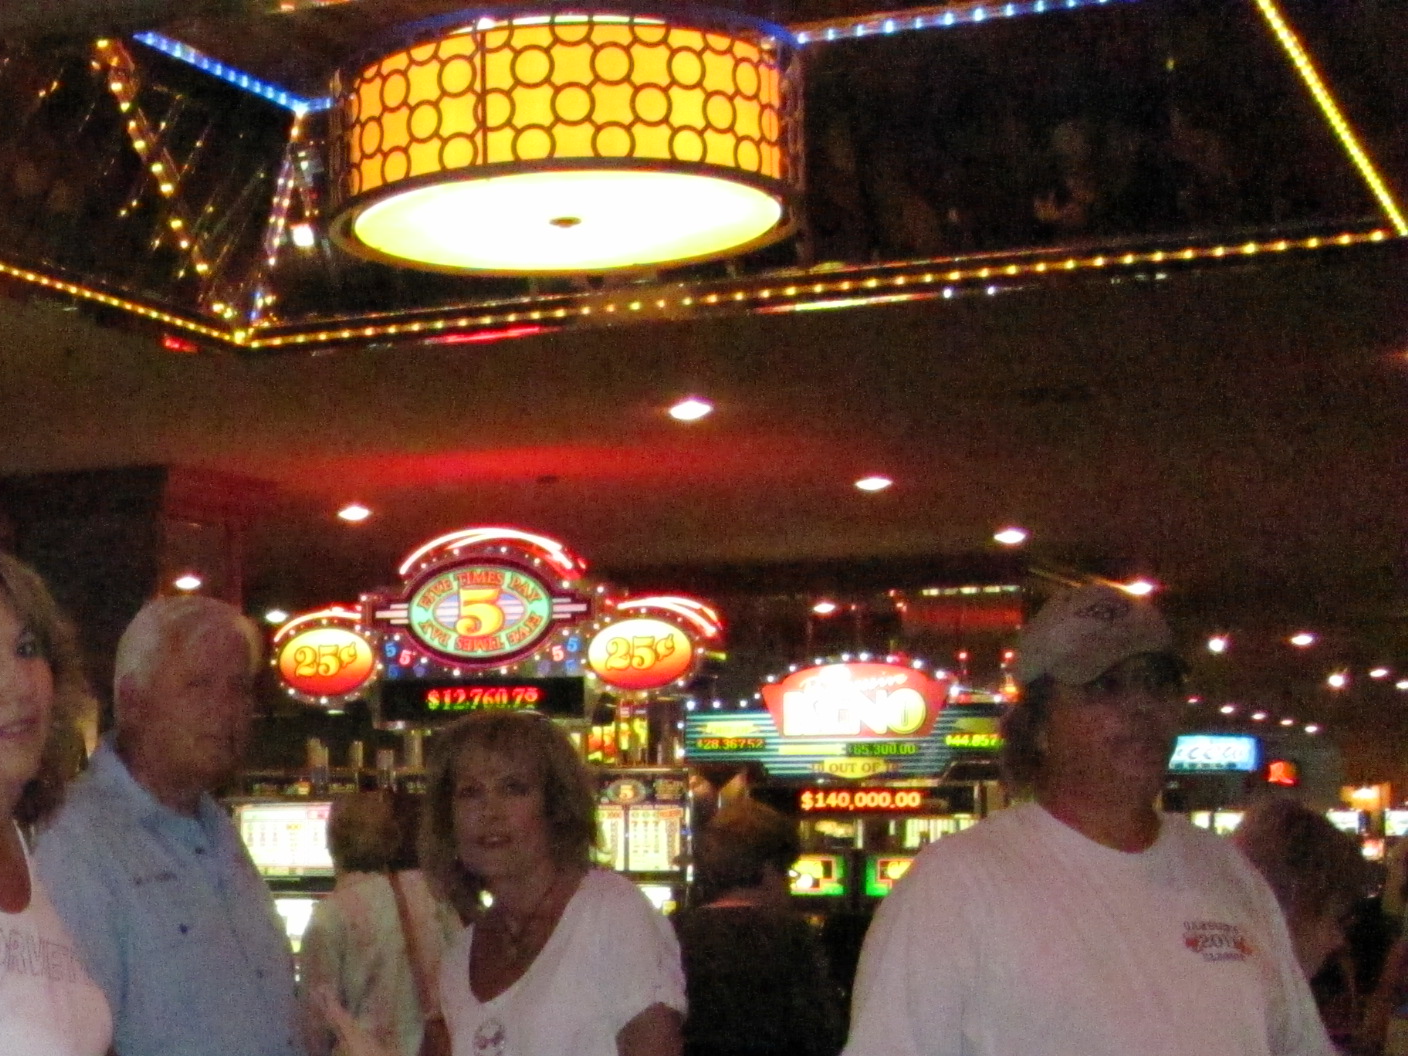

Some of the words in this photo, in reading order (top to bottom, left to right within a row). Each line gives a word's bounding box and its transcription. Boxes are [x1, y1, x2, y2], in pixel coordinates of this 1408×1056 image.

[418, 578, 453, 610] FIVE
[456, 570, 505, 587] TIMES
[510, 576, 541, 602] PAY
[456, 588, 505, 636] 5
[783, 687, 927, 737] NO
[829, 763, 857, 773] OUT
[861, 762, 881, 773] OF
[800, 790, 921, 811] $140,000.00
